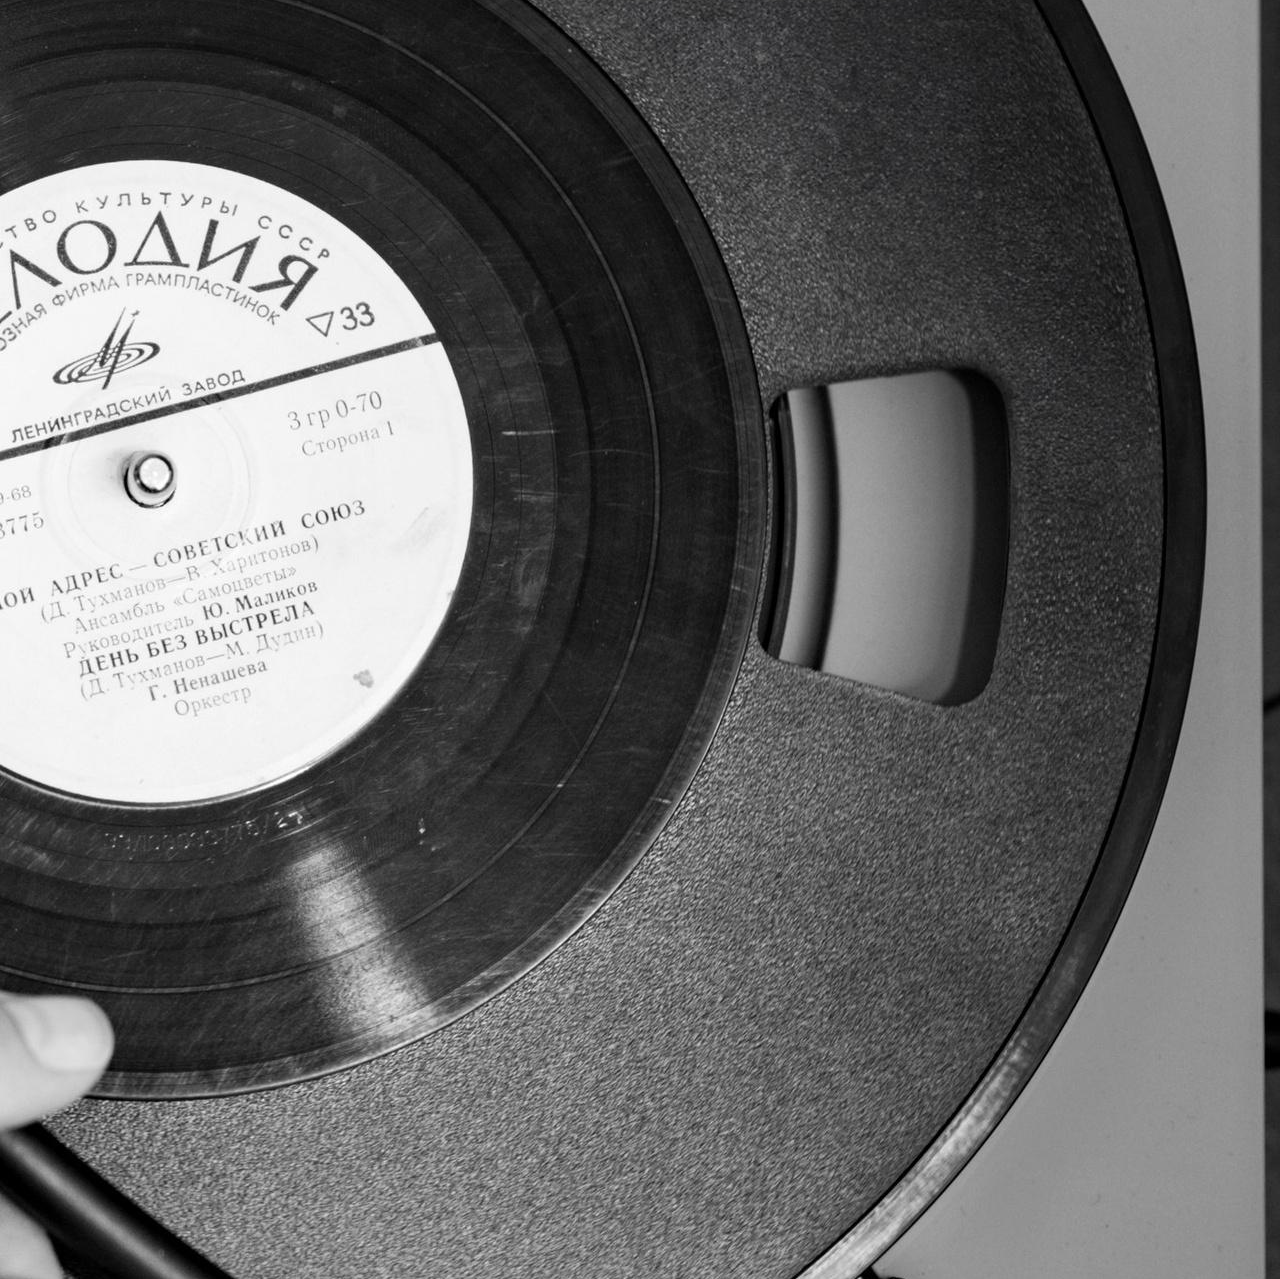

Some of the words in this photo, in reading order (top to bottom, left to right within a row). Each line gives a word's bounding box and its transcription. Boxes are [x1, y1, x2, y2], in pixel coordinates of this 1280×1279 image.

[75, 192, 238, 216] КУЛЬТУРЫ
[257, 215, 330, 260] СССР
[51, 276, 120, 308] ФИРМА
[125, 272, 281, 326] ГРАМПЛАСТИНОК
[339, 301, 376, 331] 33
[11, 386, 172, 443] ЛЕНИНГРАДСКИЙ
[181, 369, 246, 396] ЗАВОД
[287, 411, 302, 430] 3
[305, 406, 331, 428] гр
[335, 390, 383, 418] 0-70
[301, 426, 381, 457] Сторона
[40, 601, 71, 624] (Д.
[211, 534, 320, 577] Харитонов)
[50, 563, 124, 599] АДРЕС
[153, 519, 287, 569] СОВЕТСКИЙ
[300, 500, 367, 530] СОЮЗ
[63, 613, 195, 659] Руководитель
[202, 601, 232, 622] Ю.
[234, 580, 319, 614] Маликов
[74, 600, 166, 635] Ансамбль
[172, 565, 298, 608] «Самоцветы»
[79, 644, 140, 678] ДЕНЬ
[146, 633, 188, 660] БЕЗ
[195, 600, 316, 646] ВЫСТРЕЛА
[80, 677, 111, 702] (Д.
[256, 620, 325, 654] Дудин)
[148, 684, 167, 702] Г.
[173, 659, 268, 696] Ненашева
[174, 685, 252, 718] Оркестр
